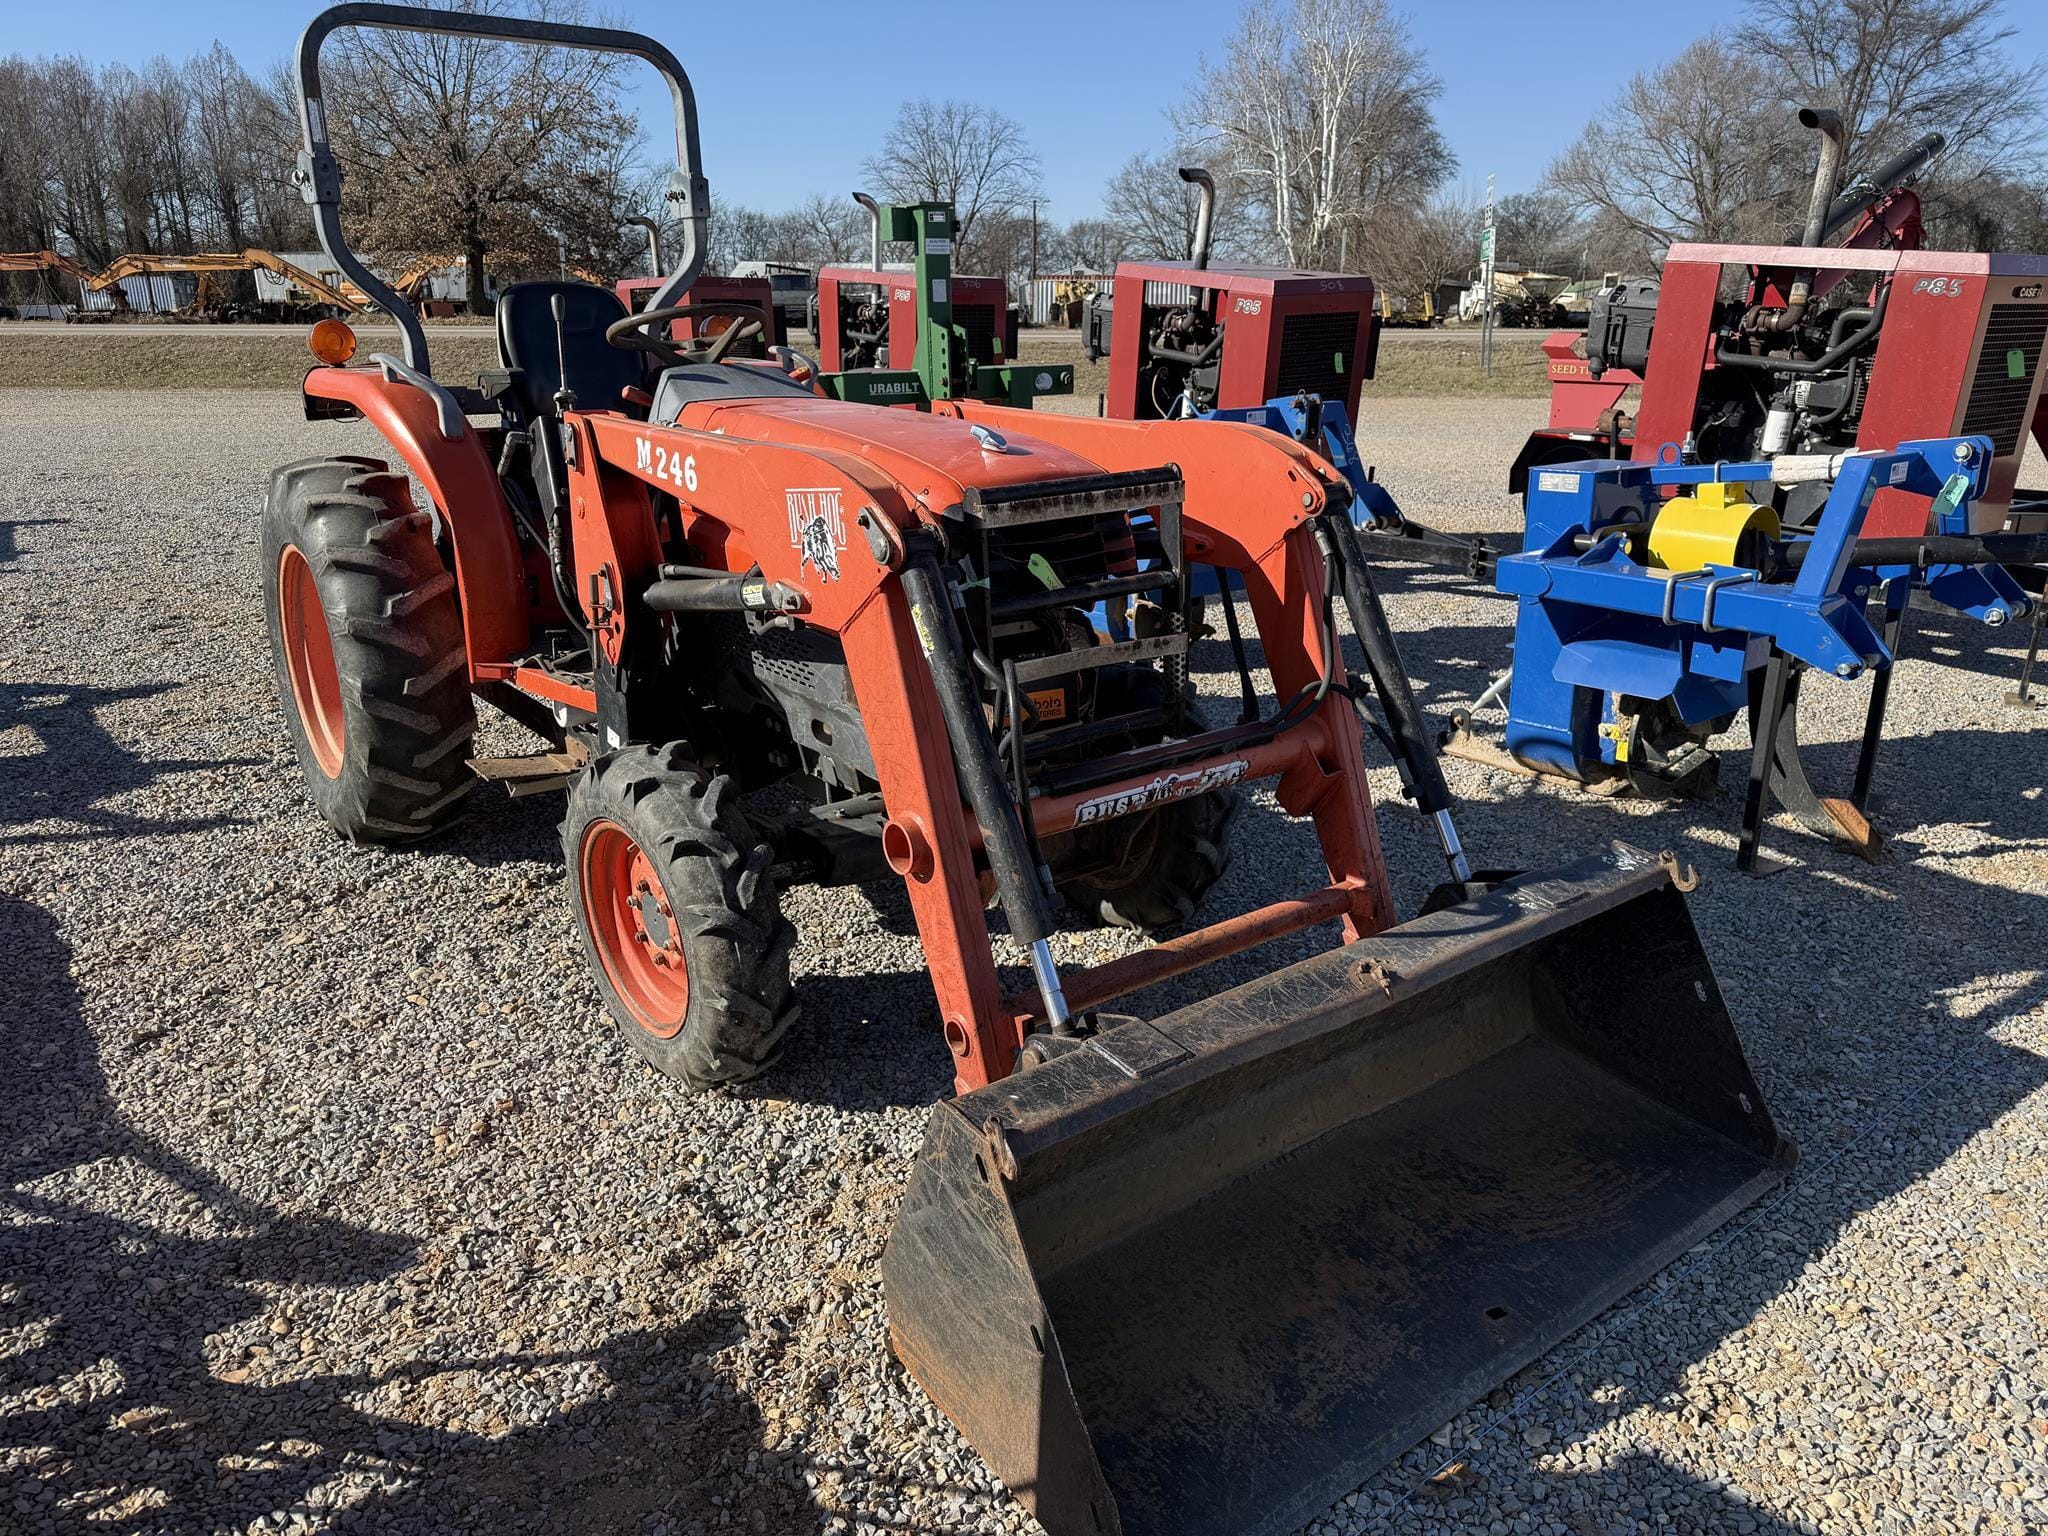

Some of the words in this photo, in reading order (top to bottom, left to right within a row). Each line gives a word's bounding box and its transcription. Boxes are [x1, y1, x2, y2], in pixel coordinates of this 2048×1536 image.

[1912, 277, 1967, 298] P85
[1234, 298, 1262, 315] P85
[1551, 364, 1577, 374] SEED
[868, 382, 920, 394] URABILT
